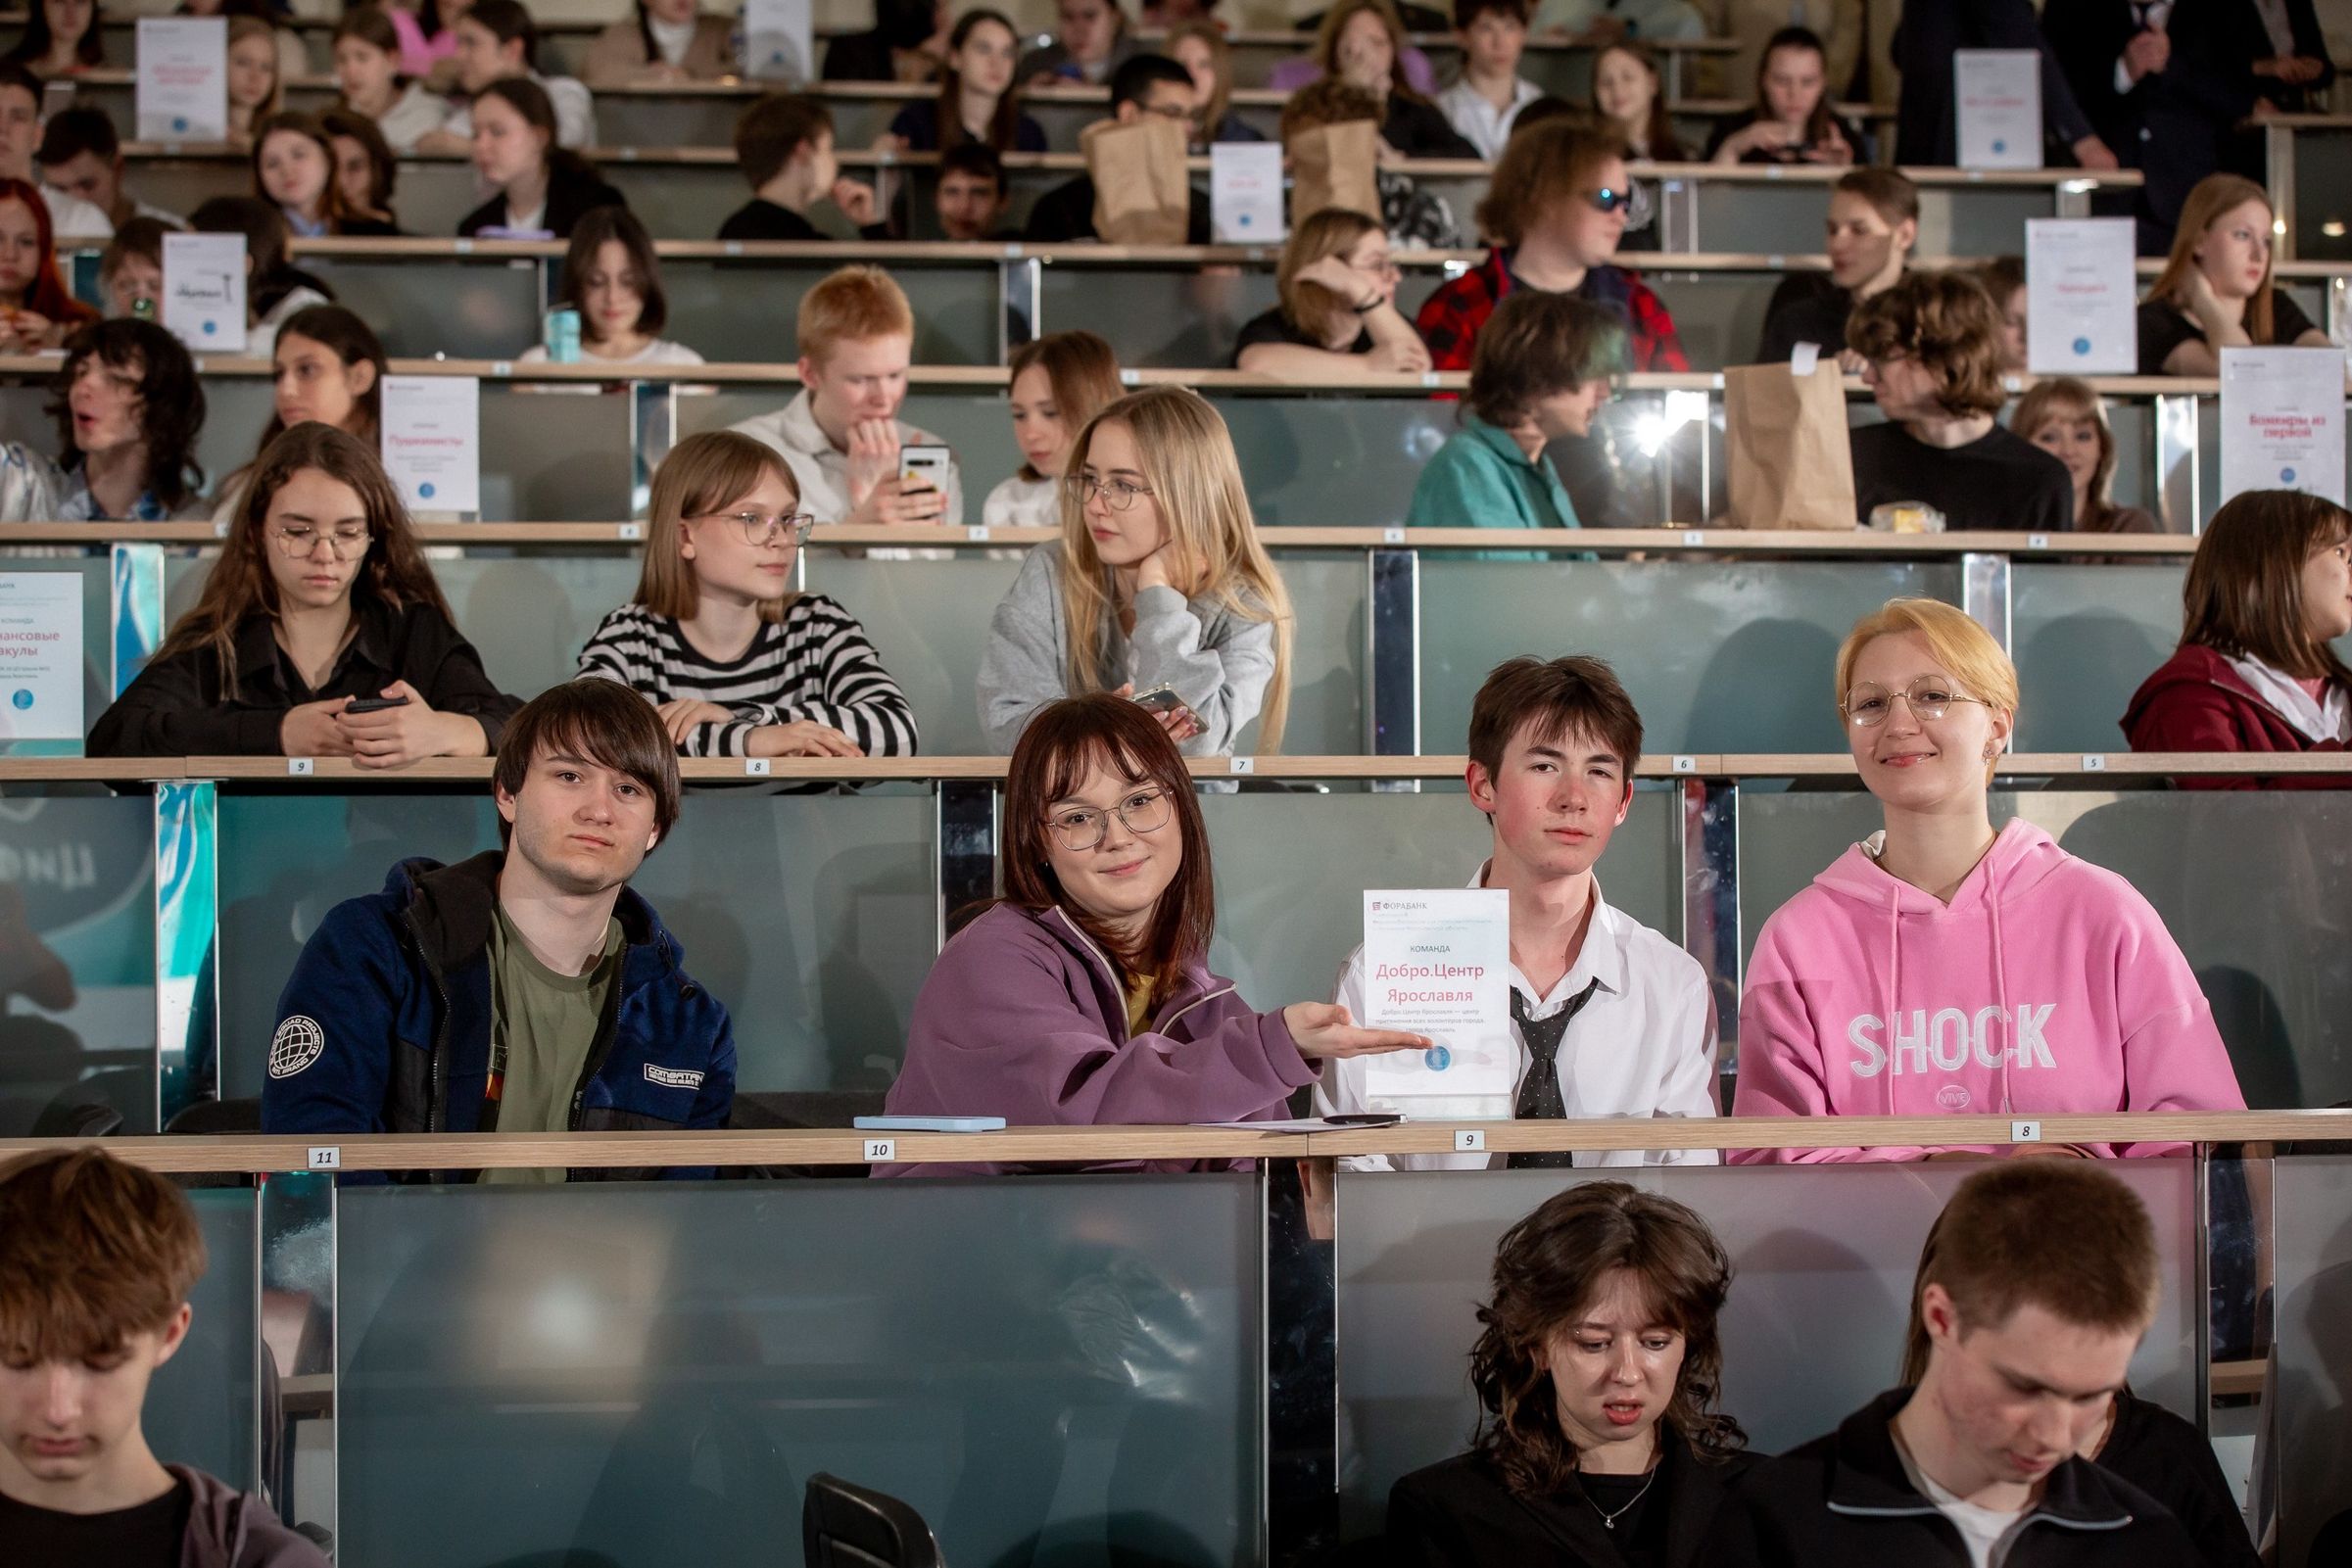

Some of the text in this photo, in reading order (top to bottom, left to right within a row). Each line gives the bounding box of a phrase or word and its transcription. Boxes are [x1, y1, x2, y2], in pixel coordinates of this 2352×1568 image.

[1376, 964, 1484, 980] Добро.Центр
[1387, 988, 1473, 1005] Ярославля
[1848, 1003, 2056, 1077] SHOCK
[2022, 1126, 2031, 1137] 8
[1465, 1134, 1474, 1146] 9
[871, 1144, 888, 1156] 10
[316, 1152, 333, 1164] 11
